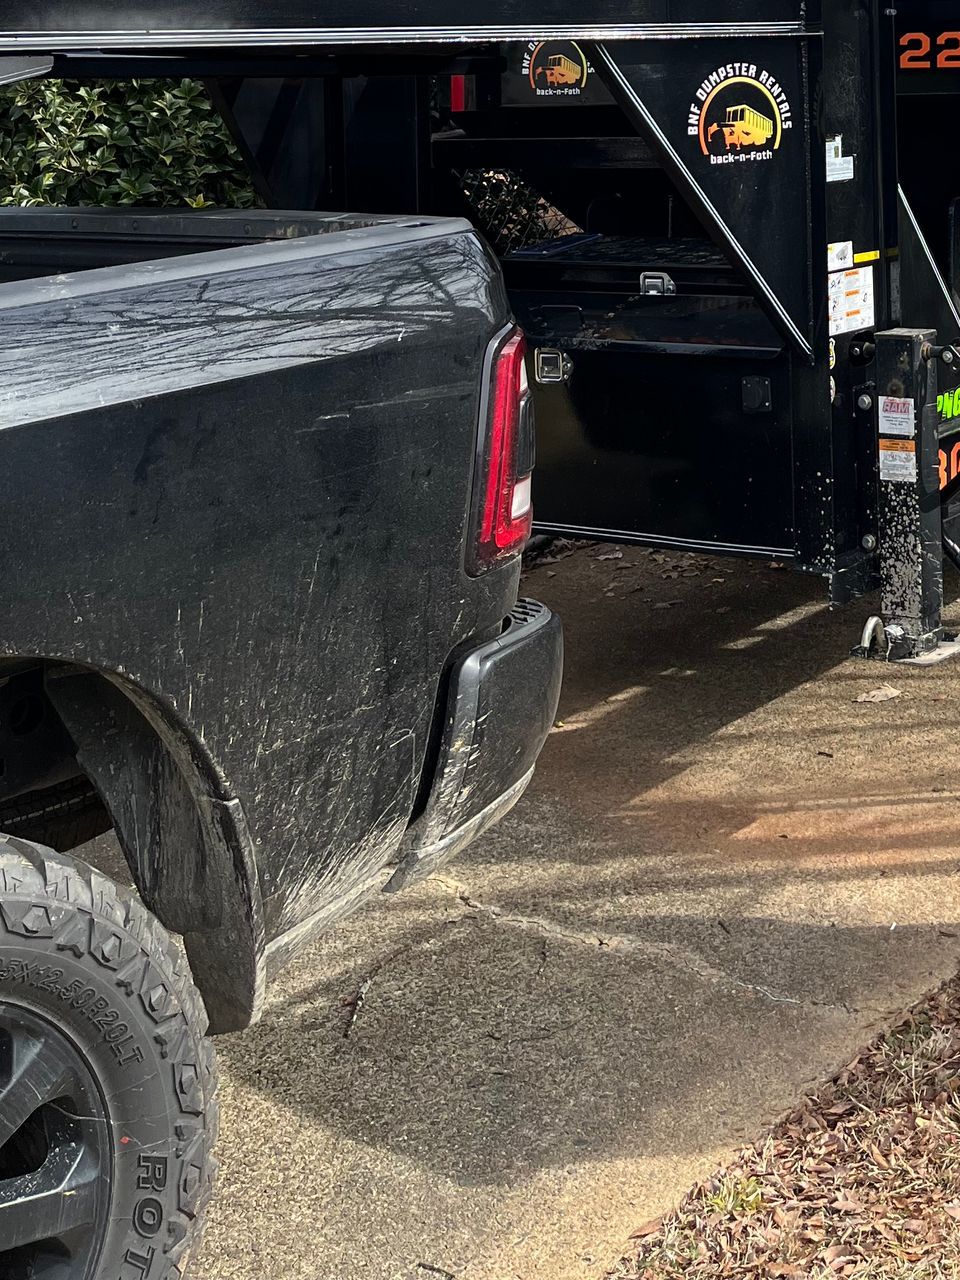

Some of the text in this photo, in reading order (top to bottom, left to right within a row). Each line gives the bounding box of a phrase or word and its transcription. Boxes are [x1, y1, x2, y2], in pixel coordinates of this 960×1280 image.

[687, 62, 793, 135] BNF DUMPSTER RENTALS
[710, 150, 773, 164] back-n-Foth
